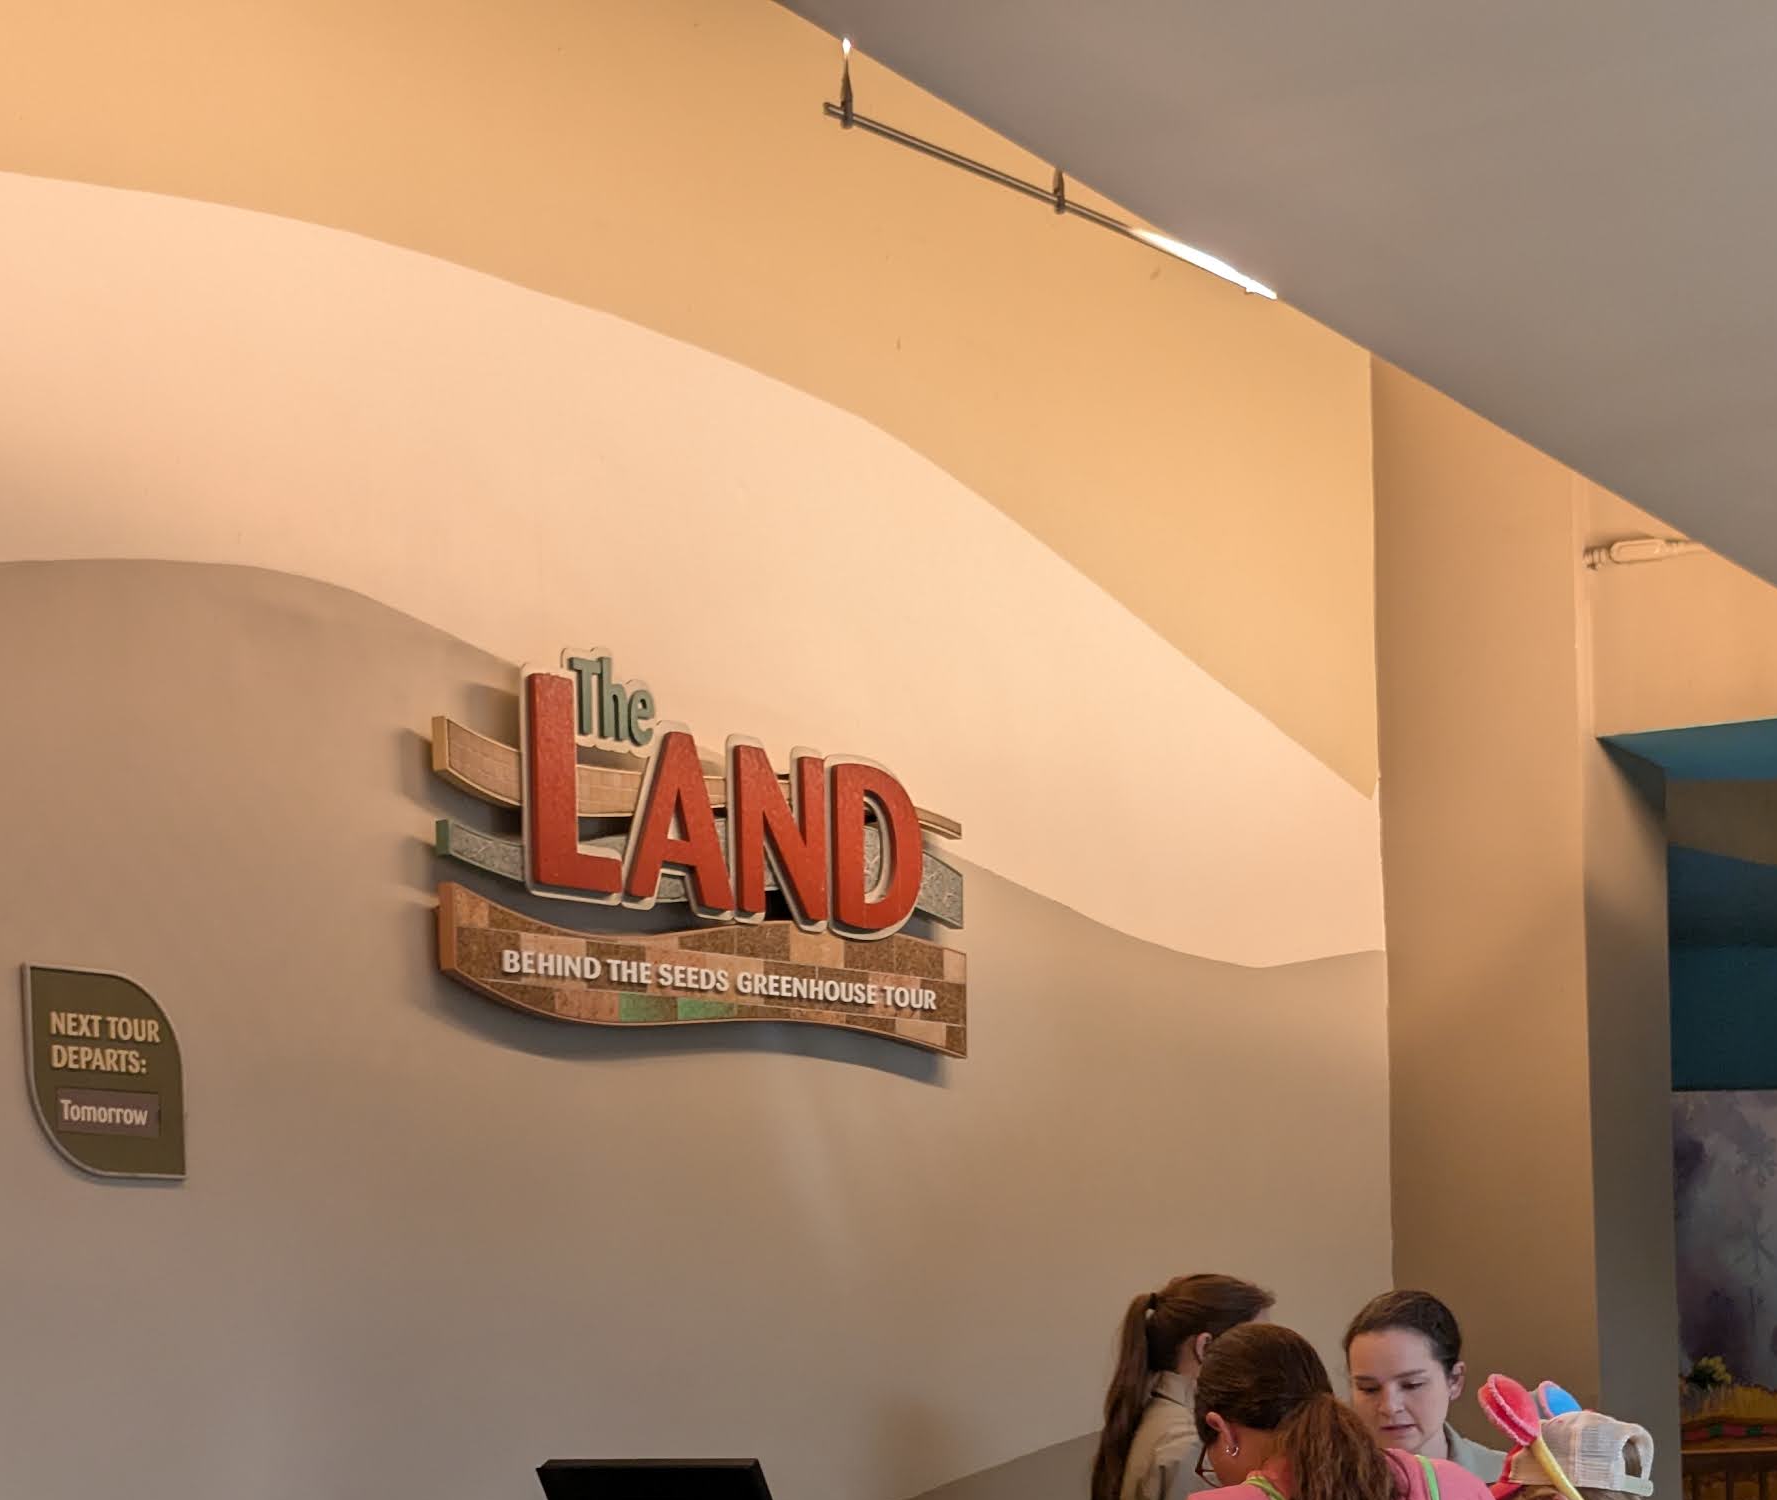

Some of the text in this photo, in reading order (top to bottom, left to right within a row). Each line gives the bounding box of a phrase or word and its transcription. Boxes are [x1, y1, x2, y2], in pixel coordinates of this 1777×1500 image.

[569, 656, 655, 747] The
[529, 673, 922, 930] LAND
[502, 949, 937, 1011] BEHIND THE SEEDS GREENHOUSE TOUR
[49, 1011, 161, 1043] NEXT TOUR
[50, 1044, 147, 1074] DEPARTS:
[60, 1098, 148, 1126] Tomorrow
